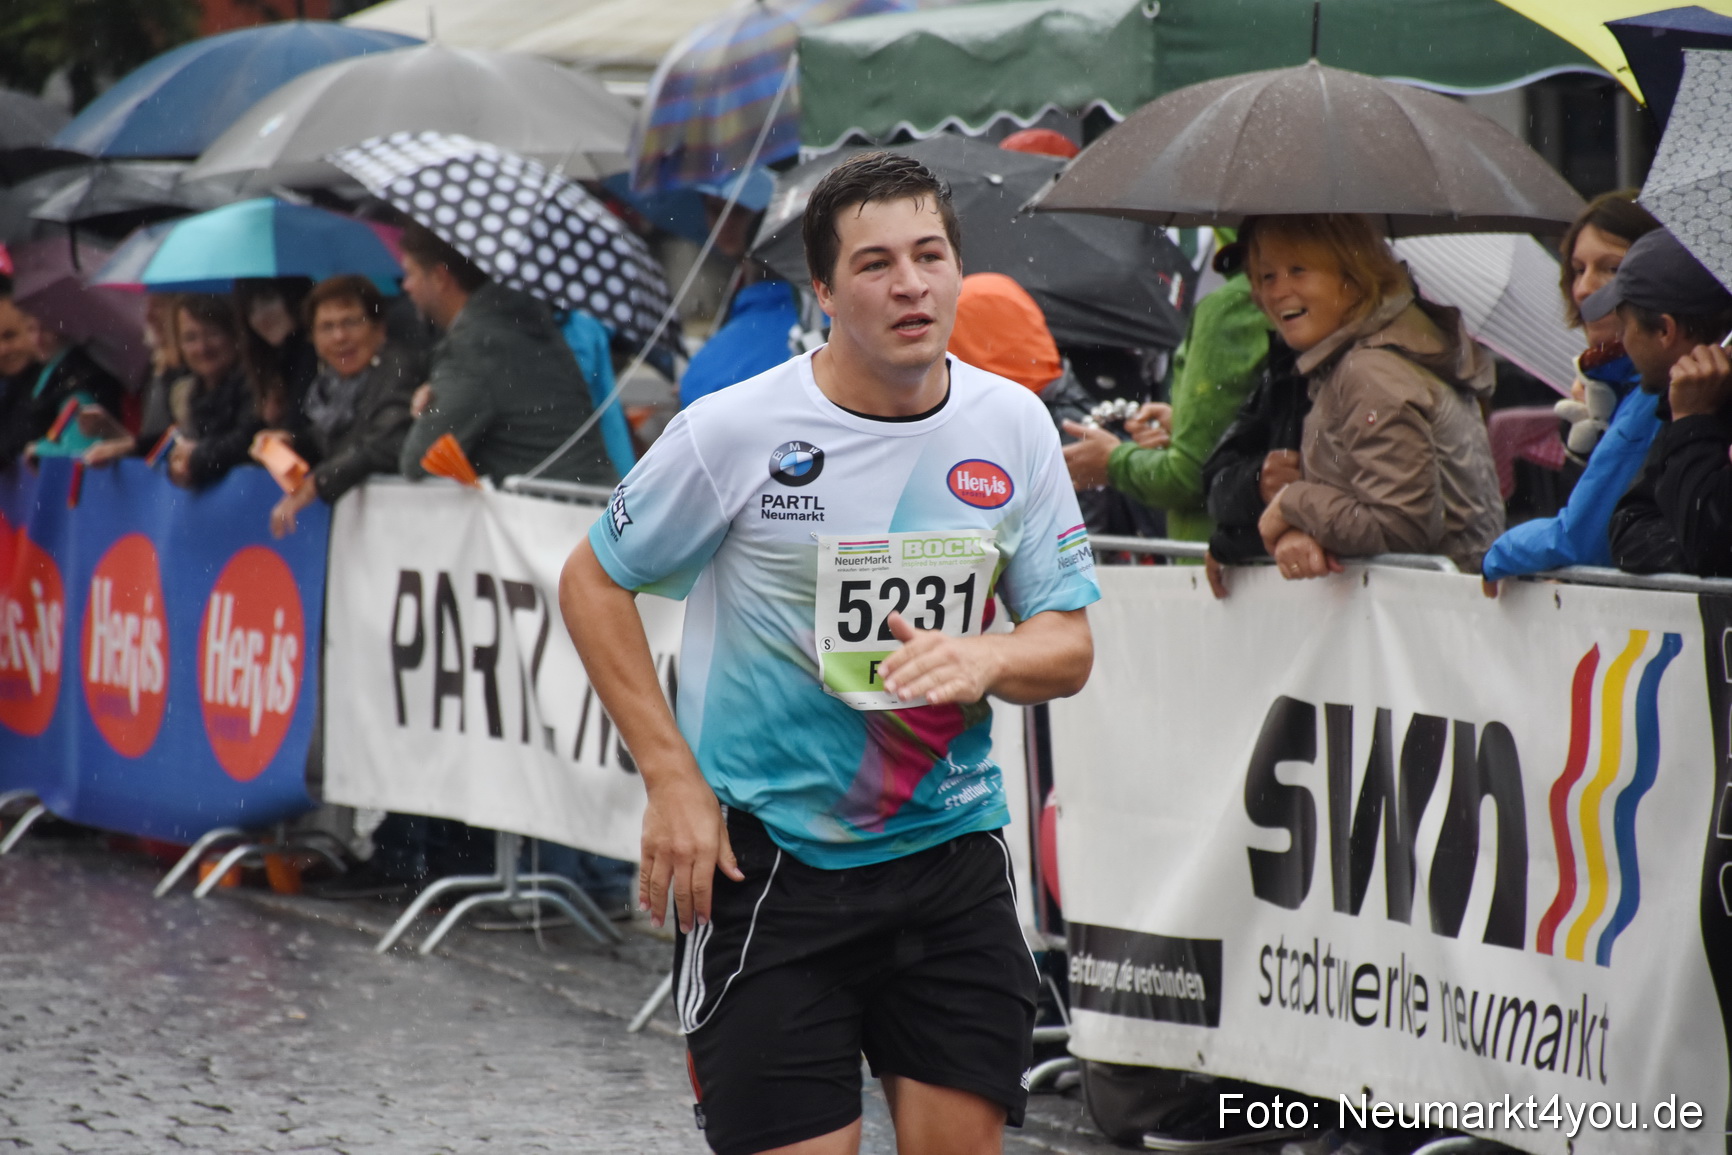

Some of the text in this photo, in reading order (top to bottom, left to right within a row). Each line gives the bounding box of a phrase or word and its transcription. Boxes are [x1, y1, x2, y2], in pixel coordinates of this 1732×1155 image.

[772, 442, 820, 461] BMW
[761, 494, 825, 510] PARTL
[956, 470, 1007, 497] Hervis
[760, 509, 825, 522] Neumarkt
[834, 555, 892, 566] NeuerMarkt
[902, 537, 986, 560] BOCK
[837, 572, 976, 643] 5231
[0, 578, 62, 696] ervis
[89, 576, 164, 716] Hervis
[824, 638, 831, 650] S
[204, 590, 298, 737] Hervis
[390, 569, 557, 757] PARTL
[1244, 695, 1529, 950] swn
[1134, 964, 1206, 1001] verbinden
[1258, 934, 1610, 1086] stadtwerke neumarkt
